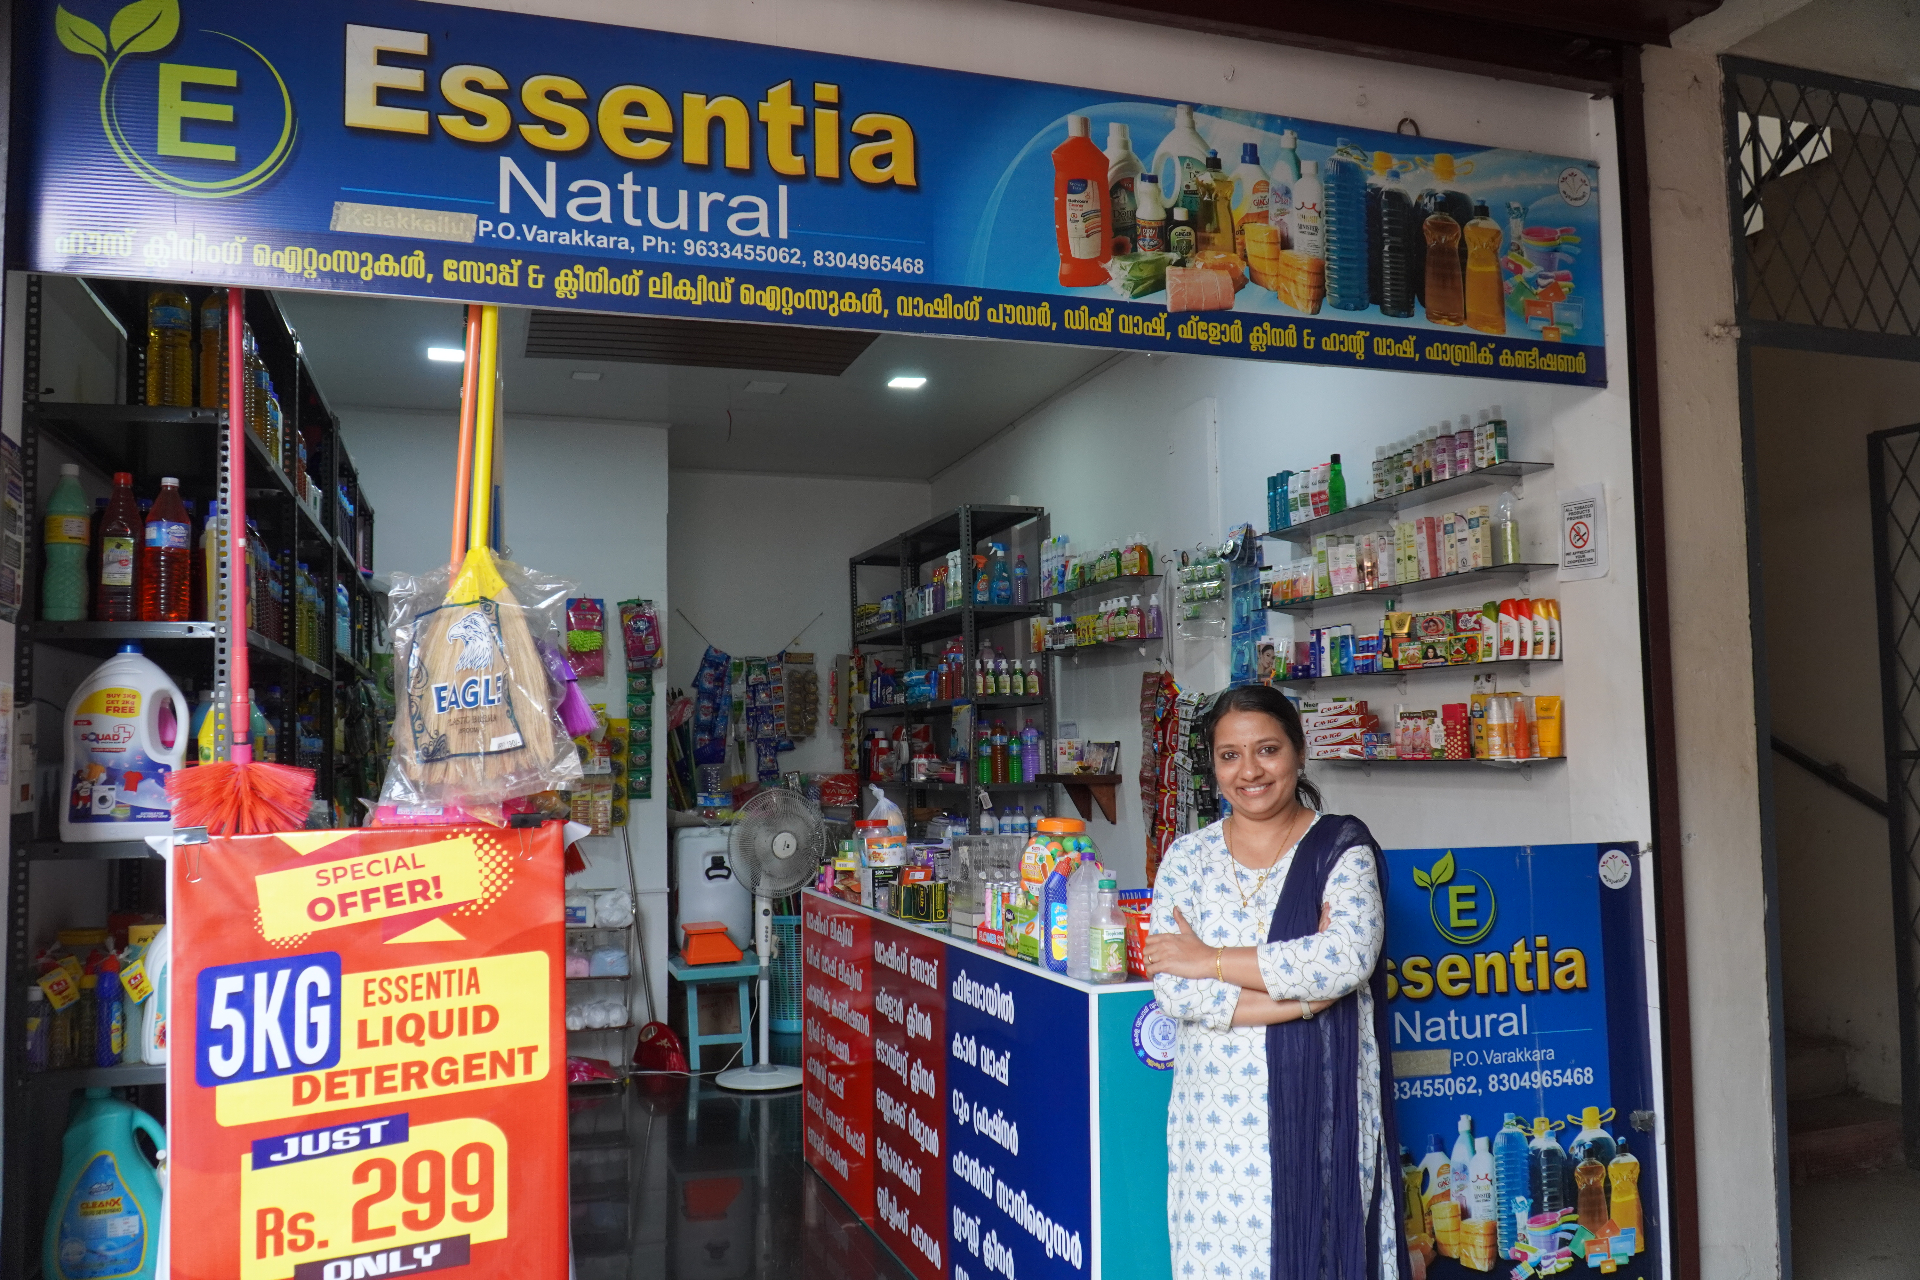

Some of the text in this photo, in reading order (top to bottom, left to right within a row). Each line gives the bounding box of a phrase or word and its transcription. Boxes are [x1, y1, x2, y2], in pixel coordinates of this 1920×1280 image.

[157, 63, 237, 162] E
[344, 23, 917, 187] Essentia
[497, 157, 788, 239] Natural
[479, 219, 634, 252] P.O.Varakkara,
[643, 236, 676, 254] Ph:
[684, 239, 806, 267] 9633455062,
[814, 250, 924, 275] 8304965468
[142, 231, 247, 267] ക്ലീനിംഗ്
[254, 244, 434, 283] ഐറ്റംസുകൾ,
[443, 258, 522, 287] സോപ്പ്
[528, 265, 545, 289] &
[554, 264, 643, 299] ക്ലീനിംഗ്
[648, 271, 735, 305] ലിക്വിഡ്
[740, 284, 889, 318] ഐറ്റംസുകൾ,
[896, 293, 983, 321] വാഷിംഗ്
[987, 301, 1057, 331] പൗഡർ,
[1064, 305, 1114, 333] ഡിഷ്
[1119, 312, 1171, 341] വാഷ്,
[1249, 322, 1297, 352] ക്ലീനർ
[1303, 329, 1315, 349] &
[1373, 335, 1420, 362] വാഷ്,
[1425, 341, 1495, 367] ഫാബ്രിക്
[1499, 347, 1586, 374] കണ്ടീഷണർ
[81, 732, 120, 744] SQUAD
[315, 852, 425, 887] SPECIAL
[306, 876, 443, 923] OFFER!
[1448, 884, 1477, 928] E
[363, 967, 480, 1008] ESSENTIA
[875, 940, 938, 990] വാഷിംഗ് സോപ്പ്
[1386, 935, 1588, 999] sentia
[953, 969, 1015, 1025] ഫിനോയിൽ
[208, 965, 331, 1078] 5KG
[357, 1004, 500, 1050] LIQUID
[906, 1003, 932, 1041] ക്ലീനർ
[1395, 1005, 1528, 1044] Natural
[292, 1045, 538, 1107] DETERGENT
[910, 1058, 935, 1099] ക്ലീനർ
[952, 1032, 1010, 1087] കാർ വാഷ്
[1453, 1047, 1555, 1067] P.O.Varakkara
[1488, 1067, 1594, 1092] 8304965468
[953, 1088, 970, 1126] റൂം
[270, 1120, 390, 1162] JUST
[908, 1108, 939, 1158] റിമൂവർ
[256, 1141, 494, 1260] Rs. 299
[952, 1150, 1082, 1270] ഹാൻഡ് സാനിറ്റൈസർ
[323, 1243, 441, 1280] ONLY
[911, 1224, 941, 1271] പൗഡർ
[983, 1229, 1015, 1280] ക്ലീനർ
